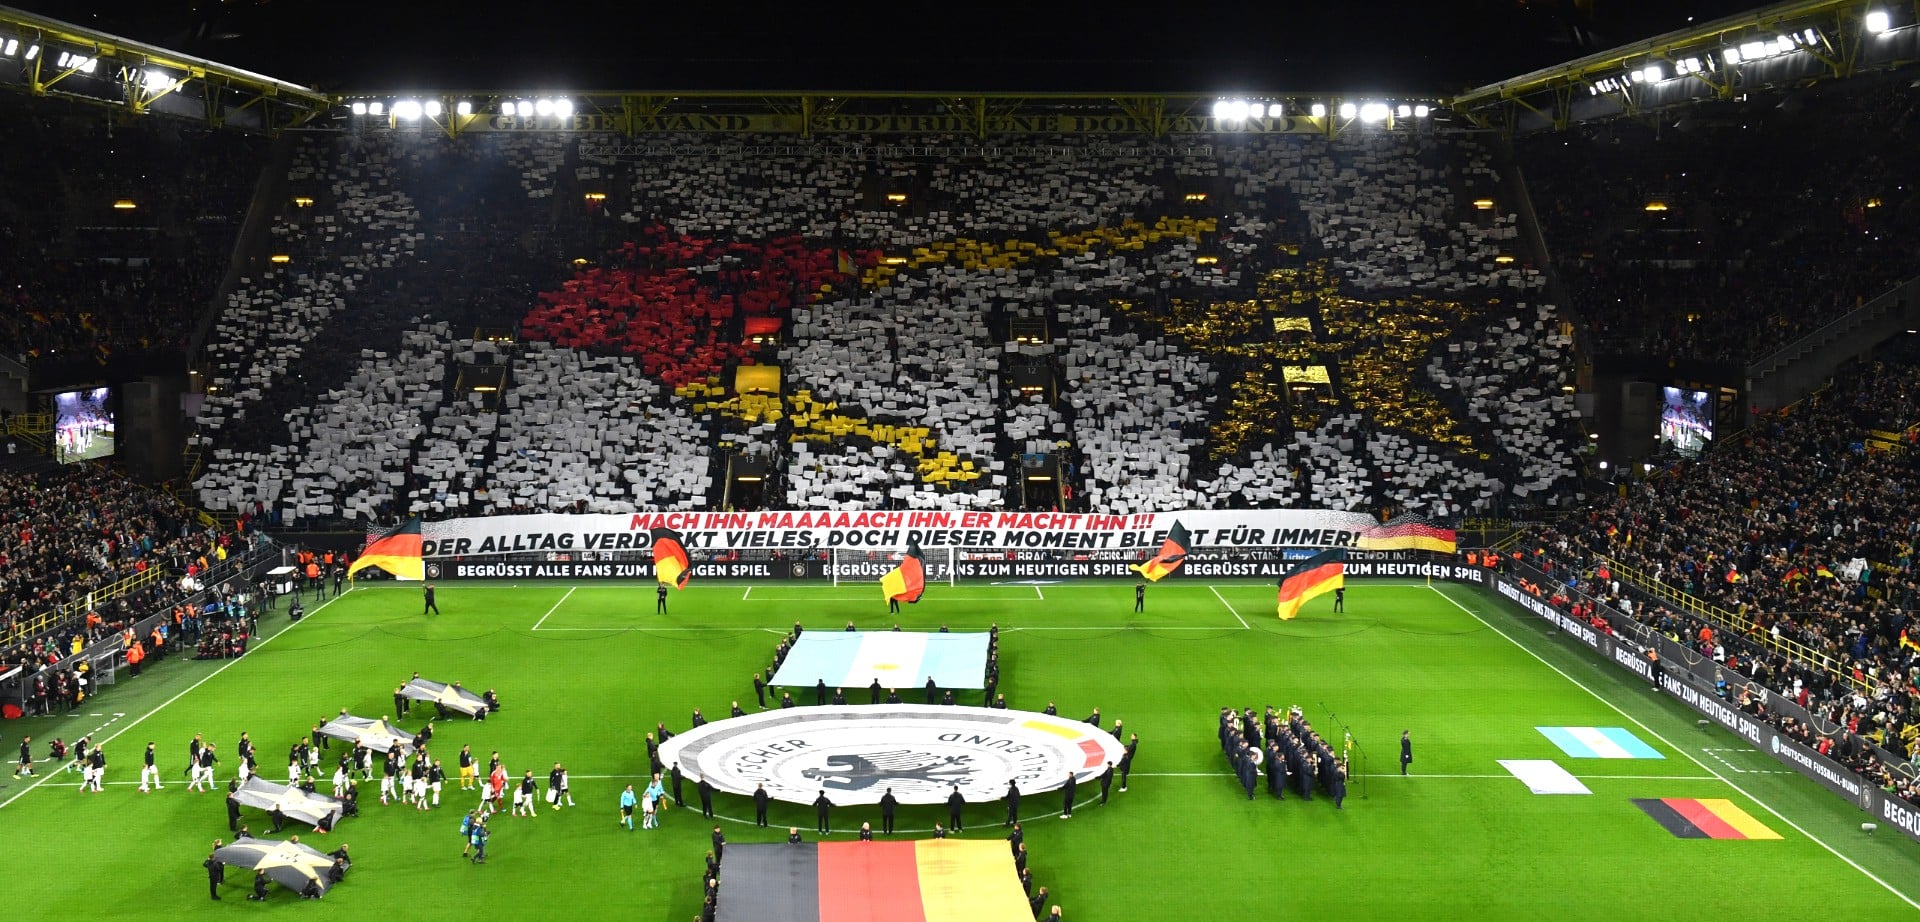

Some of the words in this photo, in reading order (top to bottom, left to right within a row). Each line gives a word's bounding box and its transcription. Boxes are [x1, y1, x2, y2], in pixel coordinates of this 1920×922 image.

[637, 115, 751, 131] WAND
[630, 513, 700, 530] MACH
[704, 513, 753, 530] IHN,
[758, 512, 904, 529] MAAAAACH
[908, 512, 957, 529] IHN,
[961, 512, 994, 529] ER
[997, 513, 1083, 530] MACHT
[1085, 514, 1129, 530] IHN
[1131, 514, 1155, 529] !!!
[422, 538, 472, 556] DER
[478, 533, 574, 553] ALLTAG
[584, 531, 718, 550] VERDKT
[726, 530, 821, 548] VIELES,
[827, 530, 900, 546] DOCH
[906, 530, 997, 546] DIESER
[1003, 531, 1114, 548] MOMENT
[1214, 525, 1266, 545] FÜR
[1271, 528, 1361, 547] IMMER!
[457, 563, 533, 577] BEGRÜSST
[535, 565, 570, 577] ALLE
[574, 565, 612, 577] FANS
[615, 565, 648, 577] ZUM
[731, 565, 771, 577] SPIEL
[938, 564, 975, 576] FANS
[978, 564, 1011, 576] ZUM
[1015, 564, 1089, 576] HEUTIGEN
[1093, 564, 1133, 576] SPIEL
[1184, 562, 1258, 576] BEGRÜSST
[1343, 563, 1372, 575] ZUM
[1376, 563, 1450, 577] HEUTIGEN
[1454, 566, 1483, 582] SPIEL
[1498, 580, 1520, 602] BEGRÜSST
[1531, 598, 1544, 616] FANS
[1543, 606, 1556, 621] ZUM
[1582, 628, 1598, 648] SPIEL
[1615, 647, 1647, 679] BEGRÜSST
[1663, 674, 1682, 696] FANS
[1682, 684, 1699, 706] ZUM
[1699, 695, 1738, 730] HEUTIGEN
[1738, 717, 1761, 744] SPIEL
[1780, 743, 1812, 769] DEUTSCHER
[1813, 761, 1860, 796] FUSSBALL-BUND
